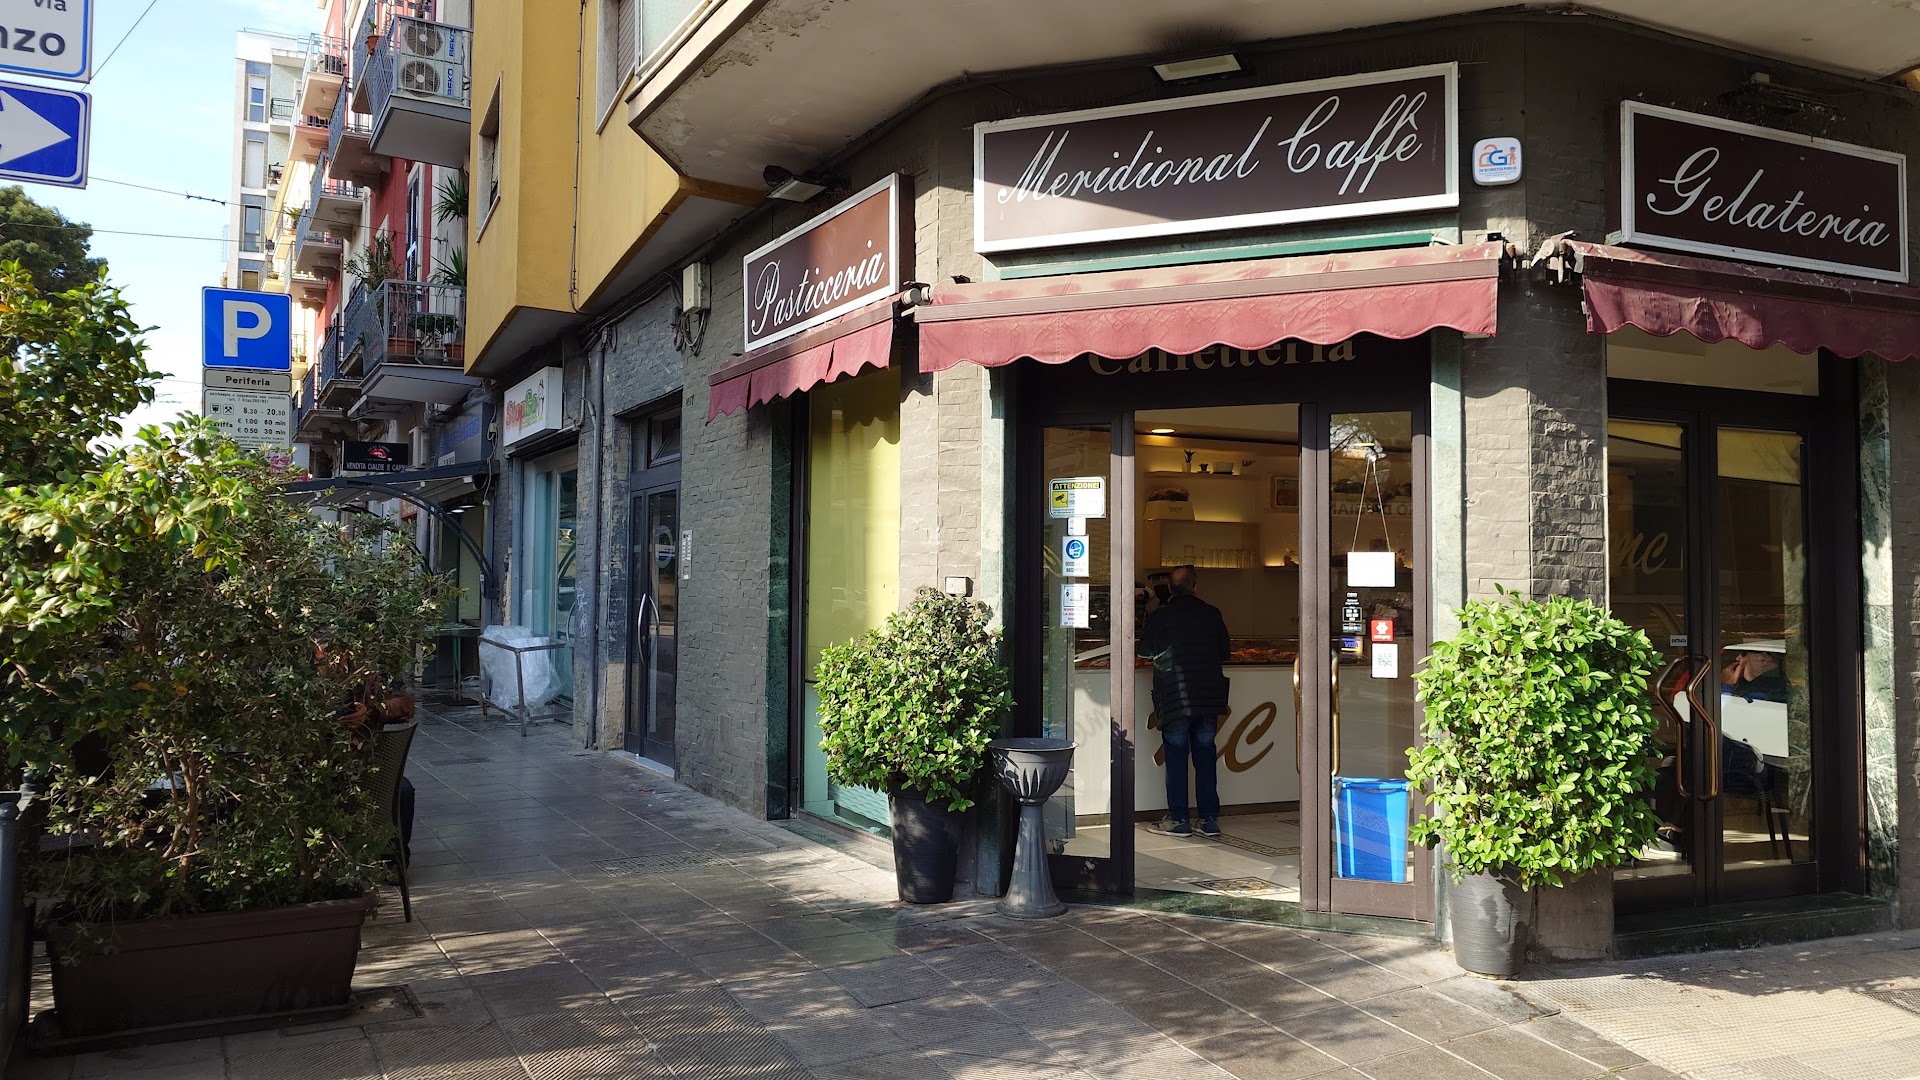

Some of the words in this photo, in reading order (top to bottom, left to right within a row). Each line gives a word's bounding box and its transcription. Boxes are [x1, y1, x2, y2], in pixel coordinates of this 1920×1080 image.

[997, 116, 1272, 204] Meridional
[1278, 91, 1429, 195] Caffè
[1646, 147, 1891, 247] Gelateria
[223, 300, 272, 357] P
[751, 240, 885, 335] Pasticceria
[225, 375, 270, 386] Periferia
